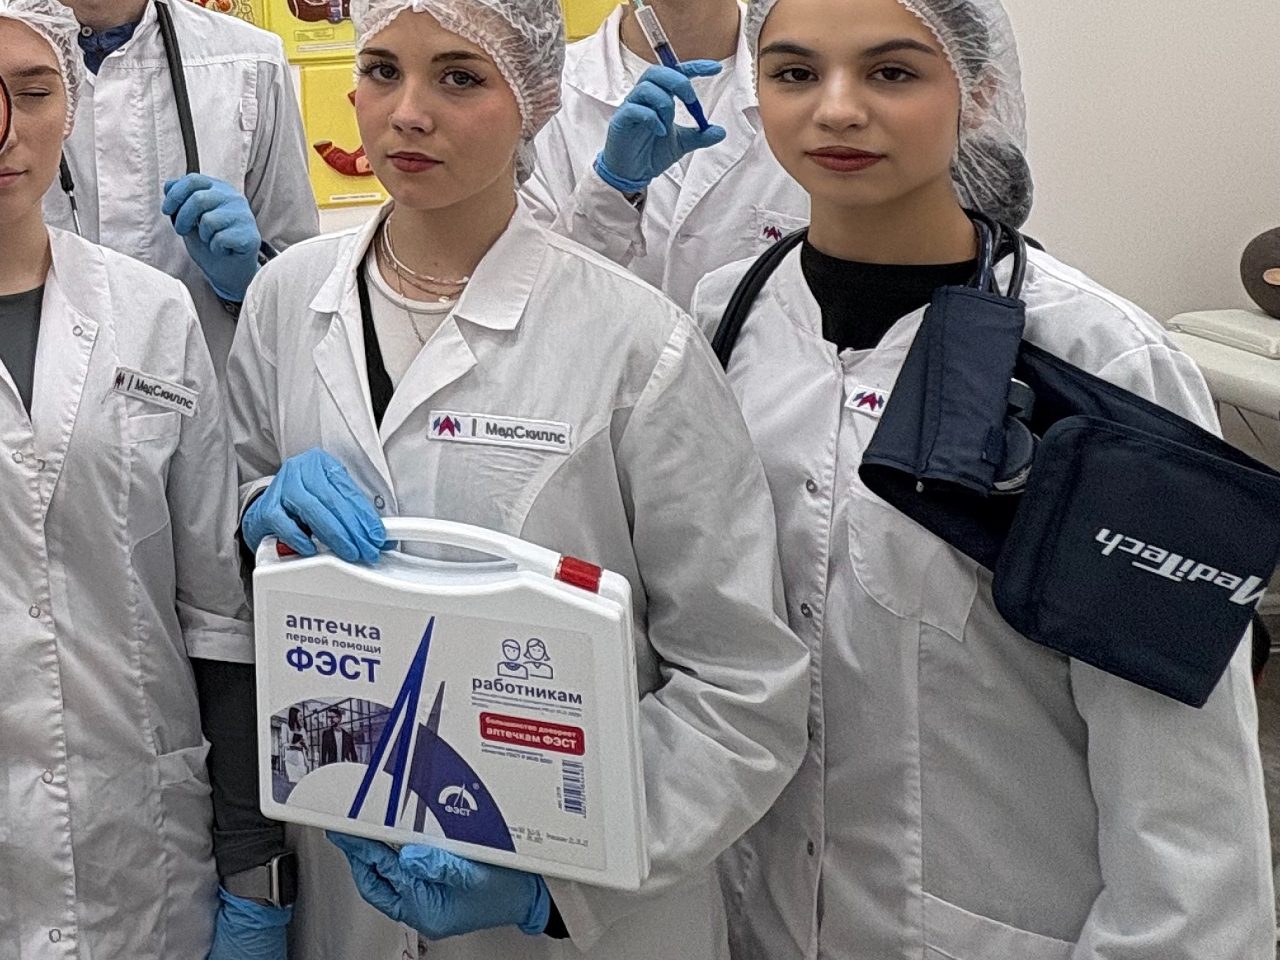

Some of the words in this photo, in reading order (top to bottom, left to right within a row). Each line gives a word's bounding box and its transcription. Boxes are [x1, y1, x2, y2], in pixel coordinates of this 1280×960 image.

[133, 378, 194, 410] МедСкиллс
[485, 421, 566, 445] МедСкиллс
[285, 614, 381, 641] аптечка
[285, 632, 329, 646] первой
[332, 639, 382, 655] помощи
[286, 646, 381, 683] ФЭСТ
[472, 678, 583, 705] работникам
[486, 727, 541, 743] аптечкам
[542, 735, 577, 749] ФЭСТ
